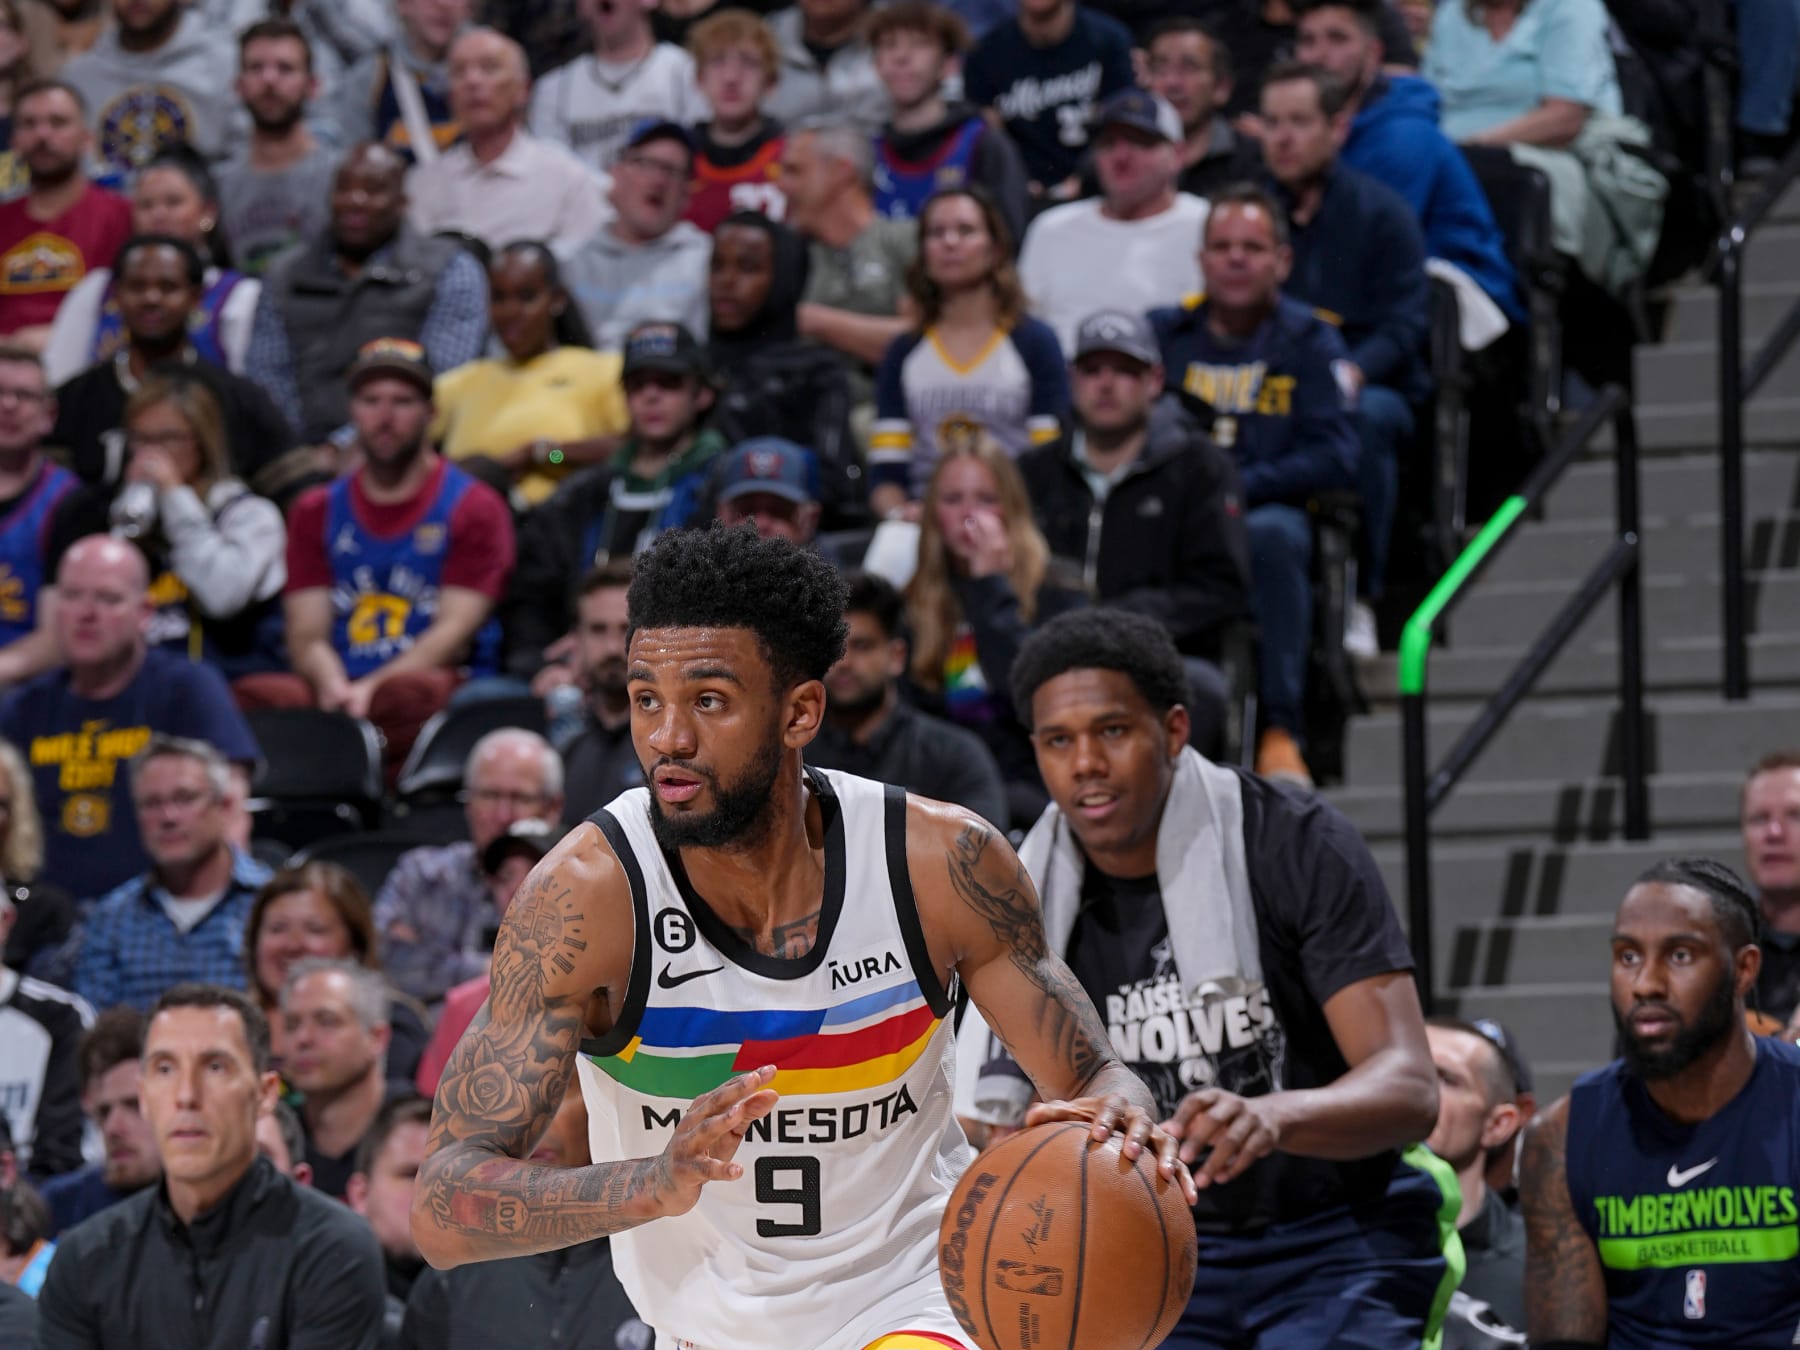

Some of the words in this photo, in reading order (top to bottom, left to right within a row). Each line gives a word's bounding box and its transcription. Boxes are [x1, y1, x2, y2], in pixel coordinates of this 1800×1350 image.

[1106, 981, 1190, 1024] RAISE
[641, 1083, 919, 1144] MNESOTA
[754, 1155, 822, 1238] 9
[1593, 1184, 1799, 1237] TIMBERWOLVES
[1637, 1238, 1752, 1263] BASKETBALL
